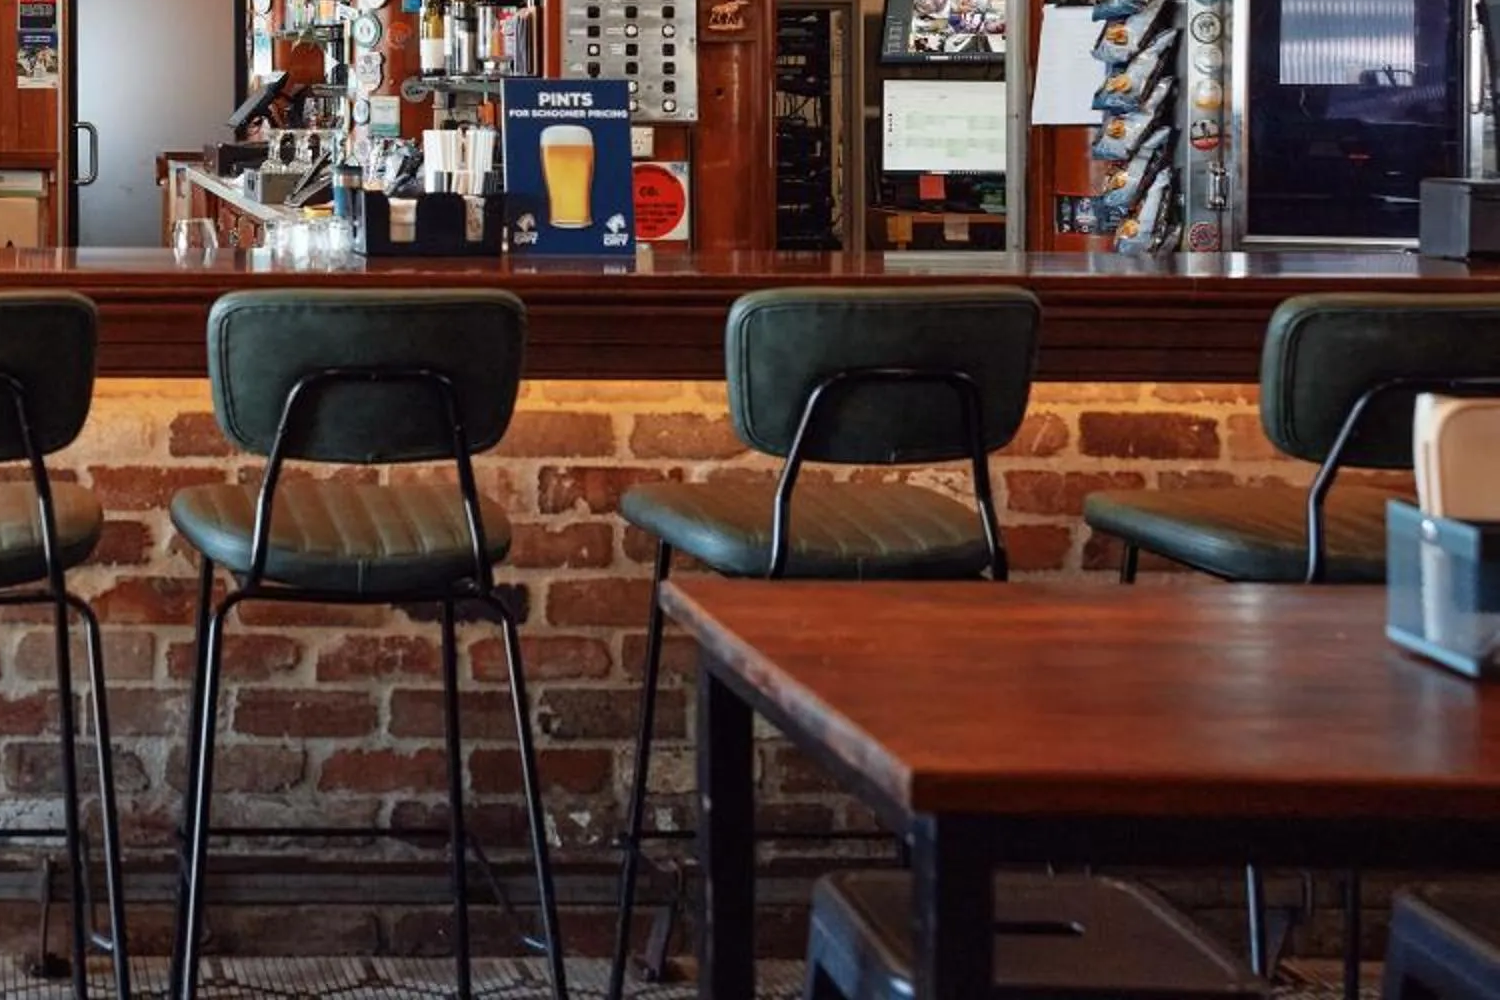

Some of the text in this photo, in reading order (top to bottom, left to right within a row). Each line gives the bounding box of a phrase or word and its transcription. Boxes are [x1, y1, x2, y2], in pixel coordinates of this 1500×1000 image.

[538, 91, 594, 107] PINTS
[509, 109, 629, 119] FOR SCHOONER PRICING
